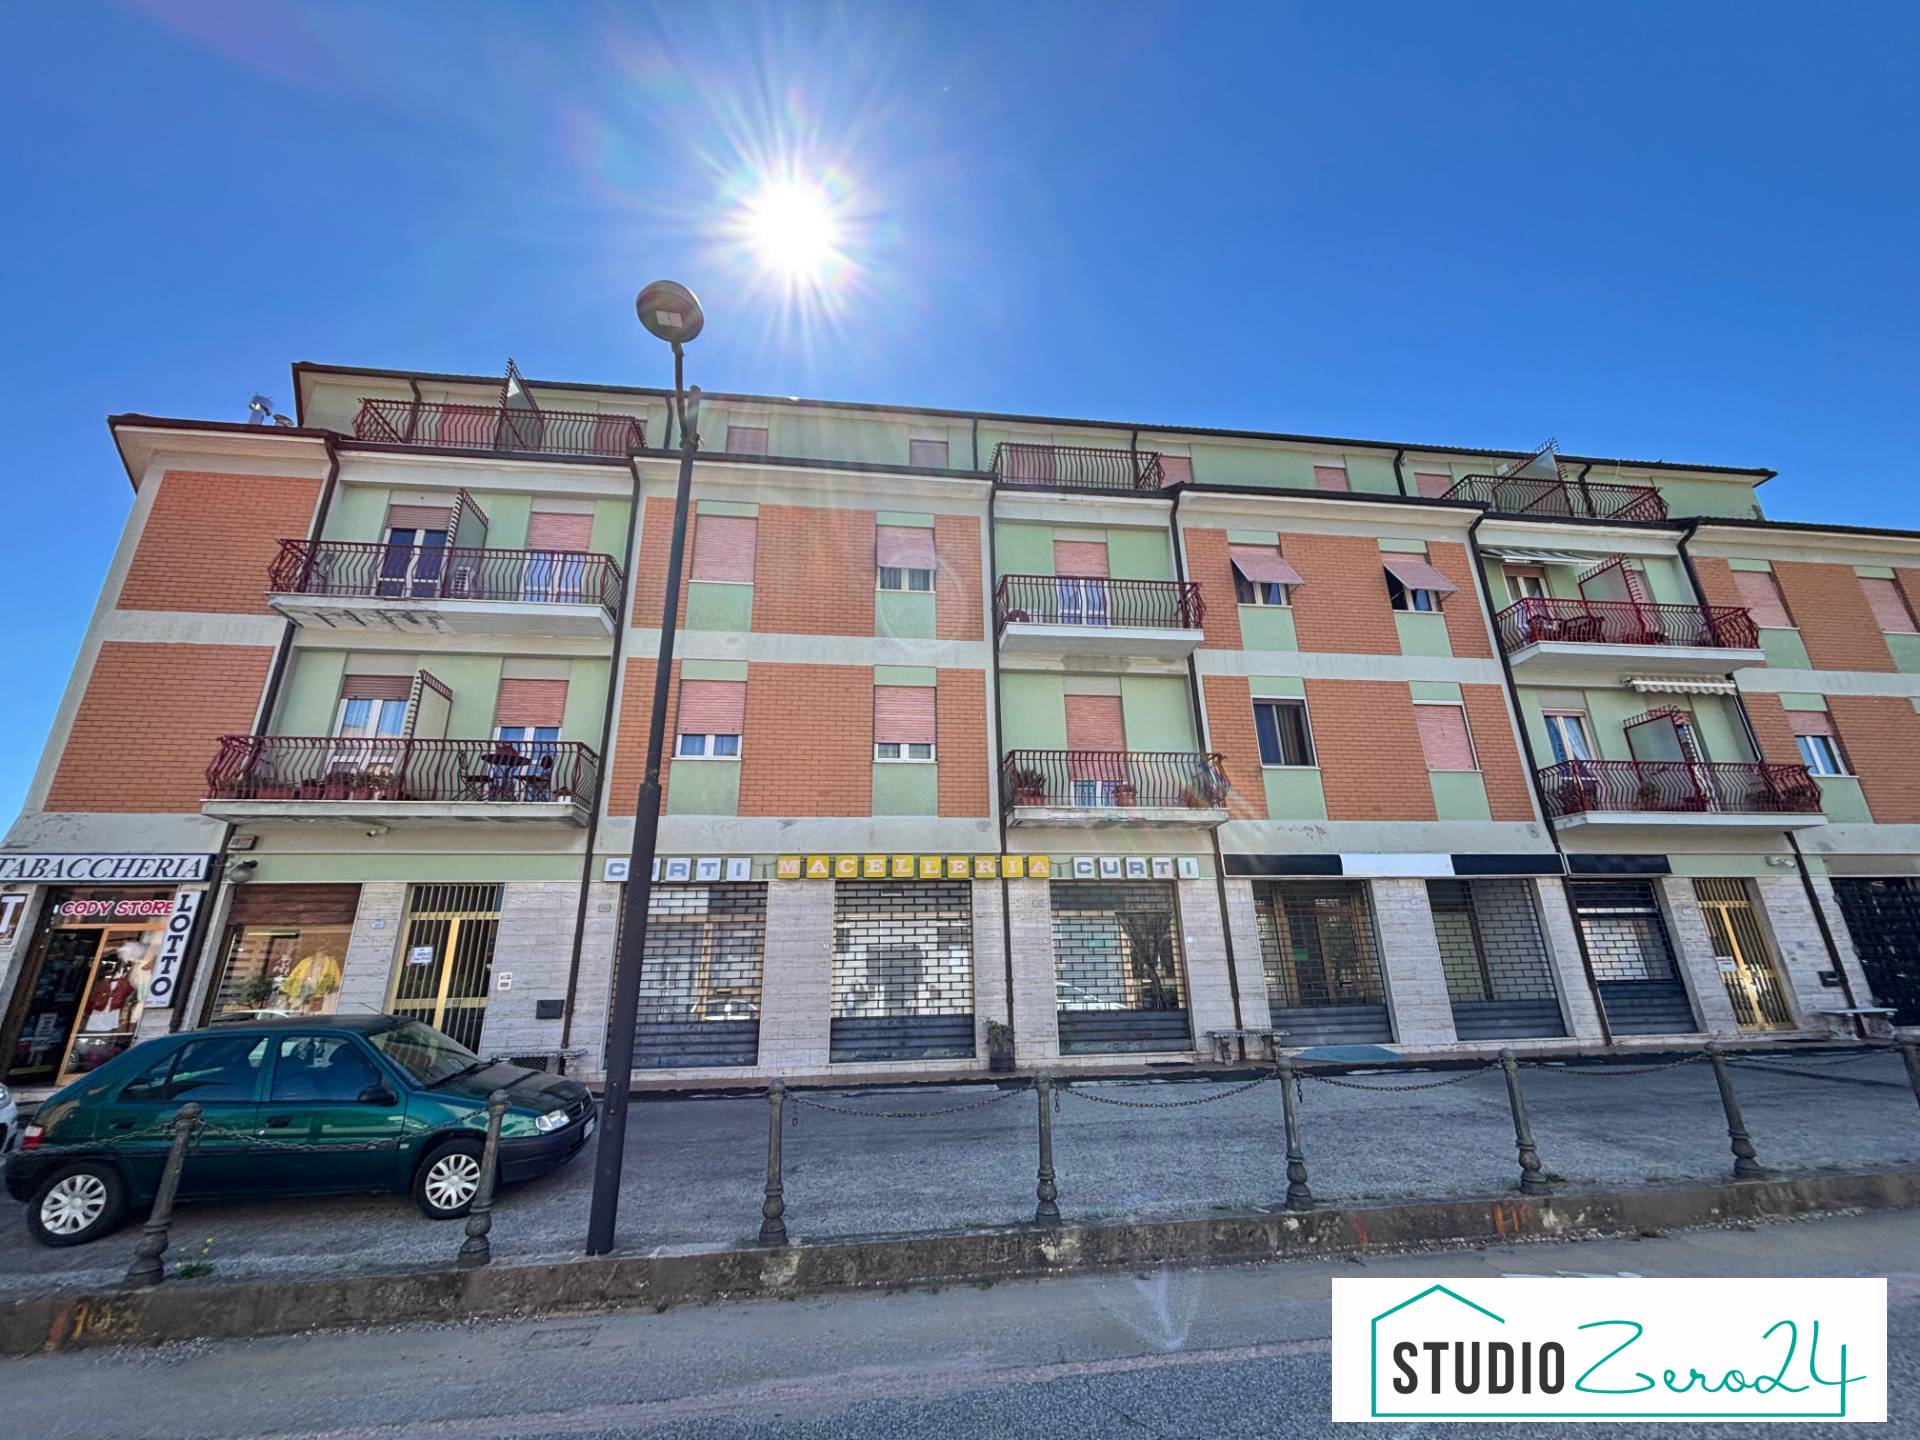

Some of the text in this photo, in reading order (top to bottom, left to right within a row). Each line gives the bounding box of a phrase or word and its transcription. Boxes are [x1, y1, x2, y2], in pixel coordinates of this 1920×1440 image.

[0, 857, 202, 879] TABACCHERIA
[608, 862, 742, 877] CRTI
[777, 858, 1048, 875] MACELLERIA
[1076, 861, 1192, 875] CURTI
[61, 900, 175, 916] CODY STORE
[150, 893, 192, 997] LOTTO
